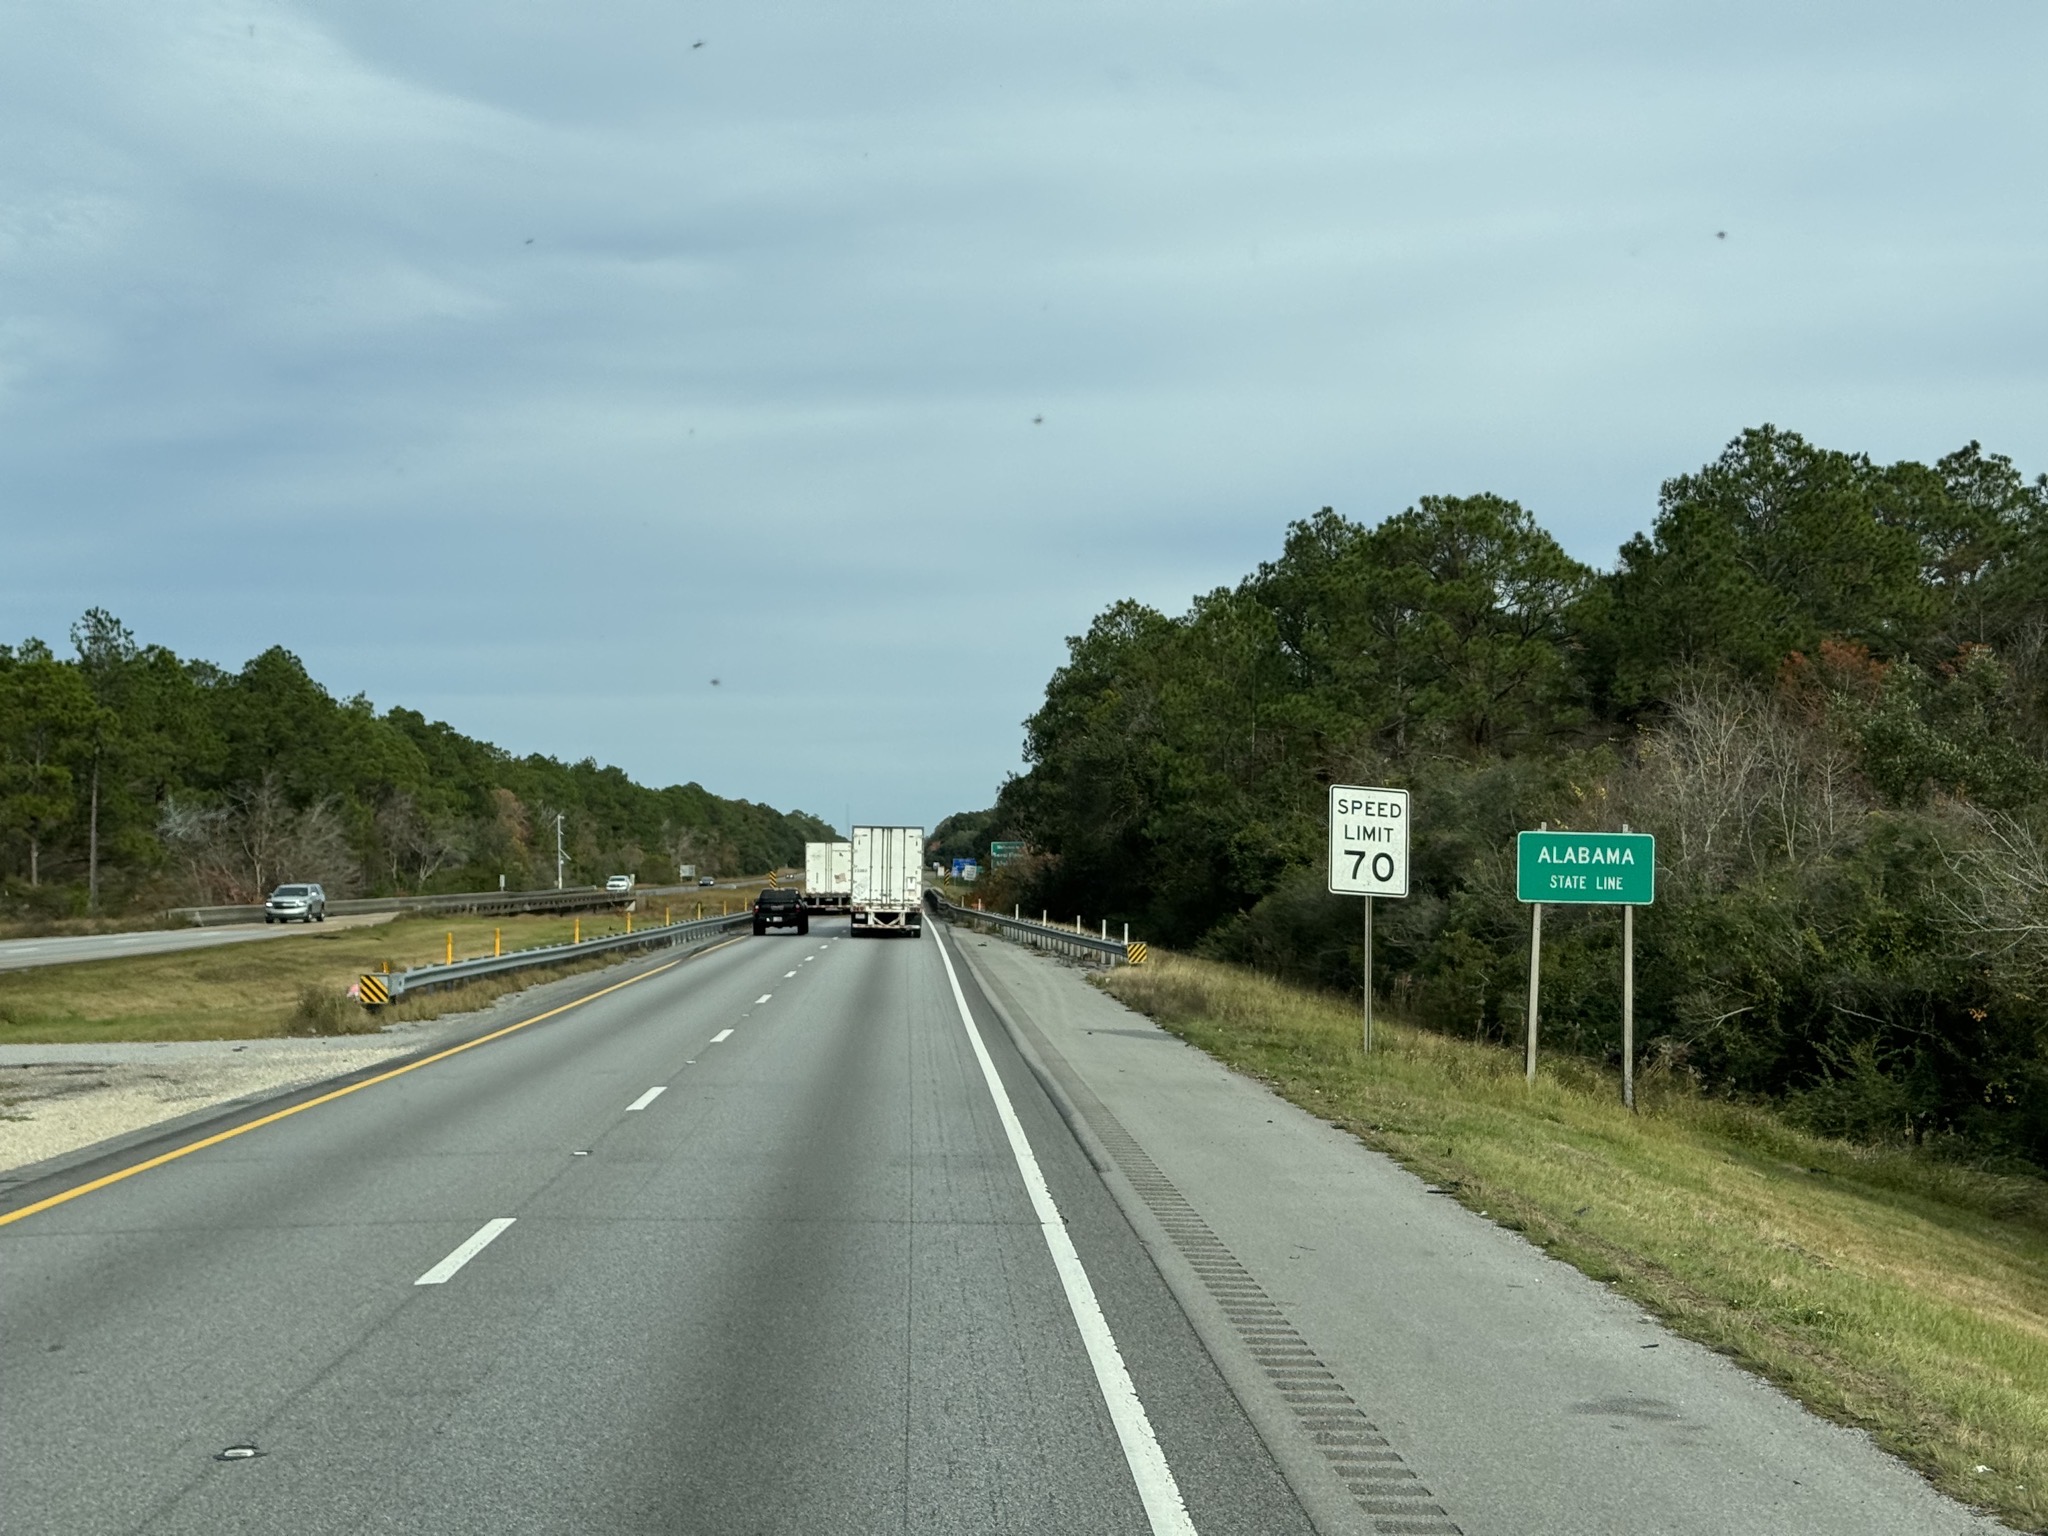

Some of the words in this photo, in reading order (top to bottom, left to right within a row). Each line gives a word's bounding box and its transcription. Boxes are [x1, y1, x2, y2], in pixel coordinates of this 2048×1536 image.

[1338, 799, 1401, 818] SPEED
[1344, 824, 1394, 843] LIMIT
[1537, 846, 1635, 865] ALABAMA
[1344, 849, 1394, 882] 70
[1549, 875, 1587, 889] STATE
[1596, 876, 1624, 890] LINE
